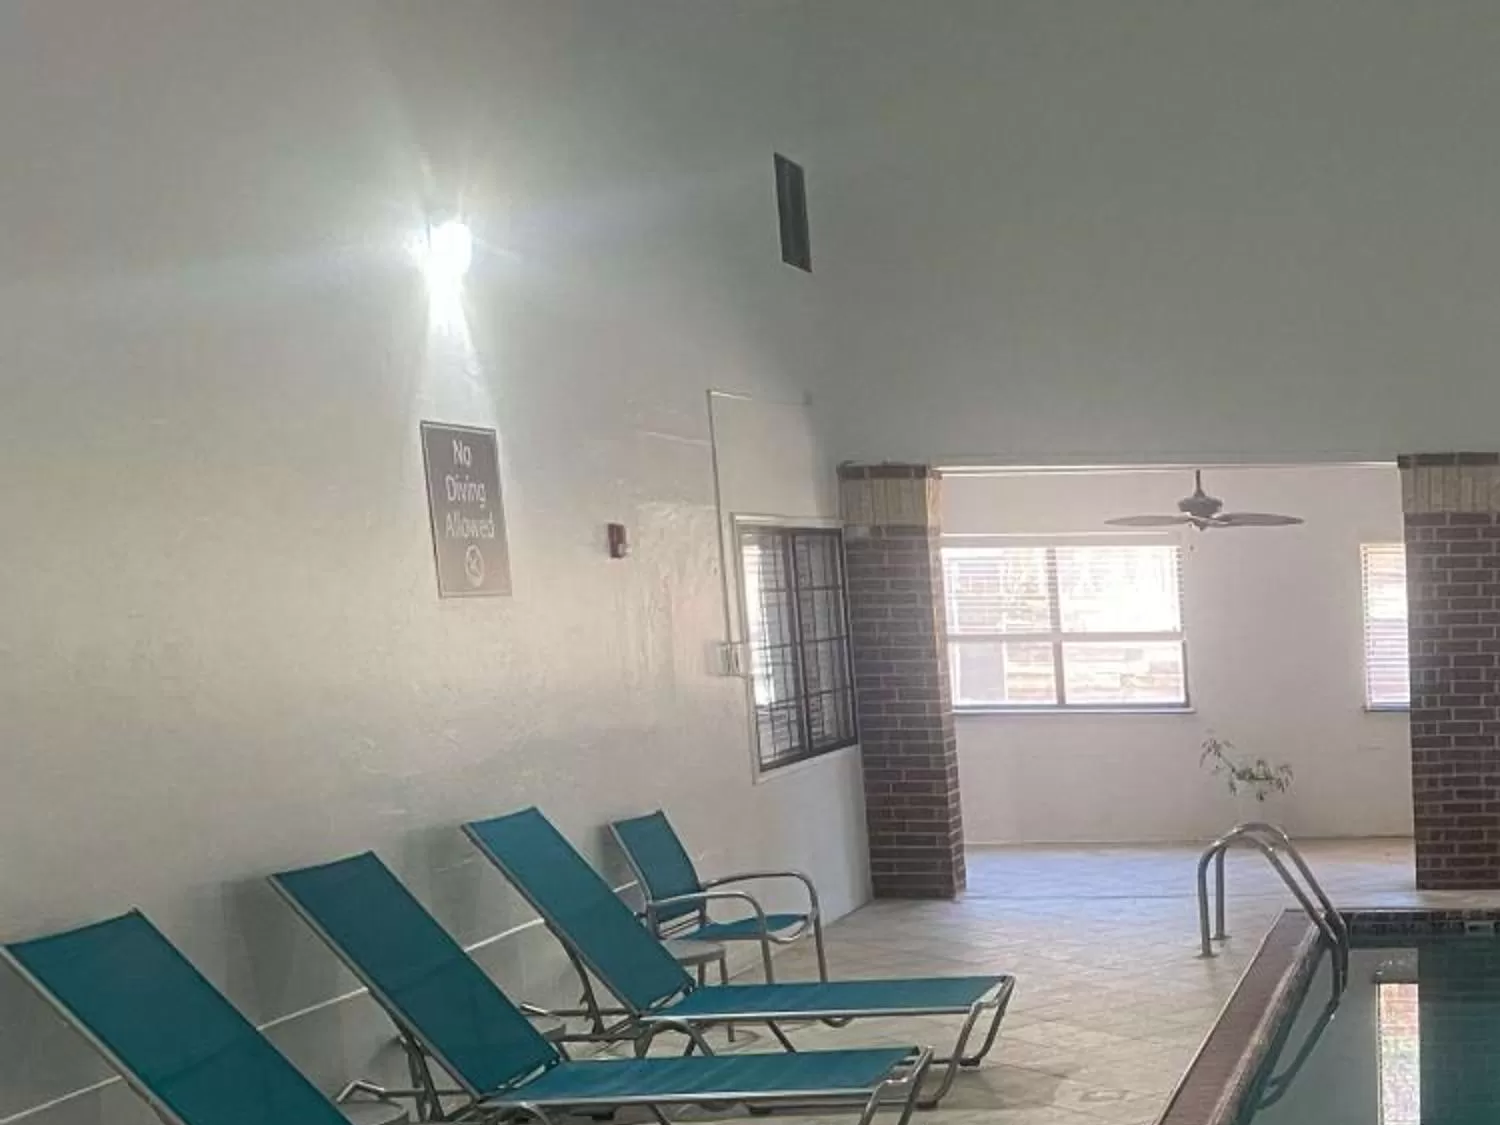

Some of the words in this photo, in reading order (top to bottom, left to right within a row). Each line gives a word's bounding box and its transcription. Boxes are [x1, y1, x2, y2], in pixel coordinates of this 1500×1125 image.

[452, 440, 472, 466] No
[445, 474, 486, 508] Diving
[445, 512, 495, 539] Allowed
